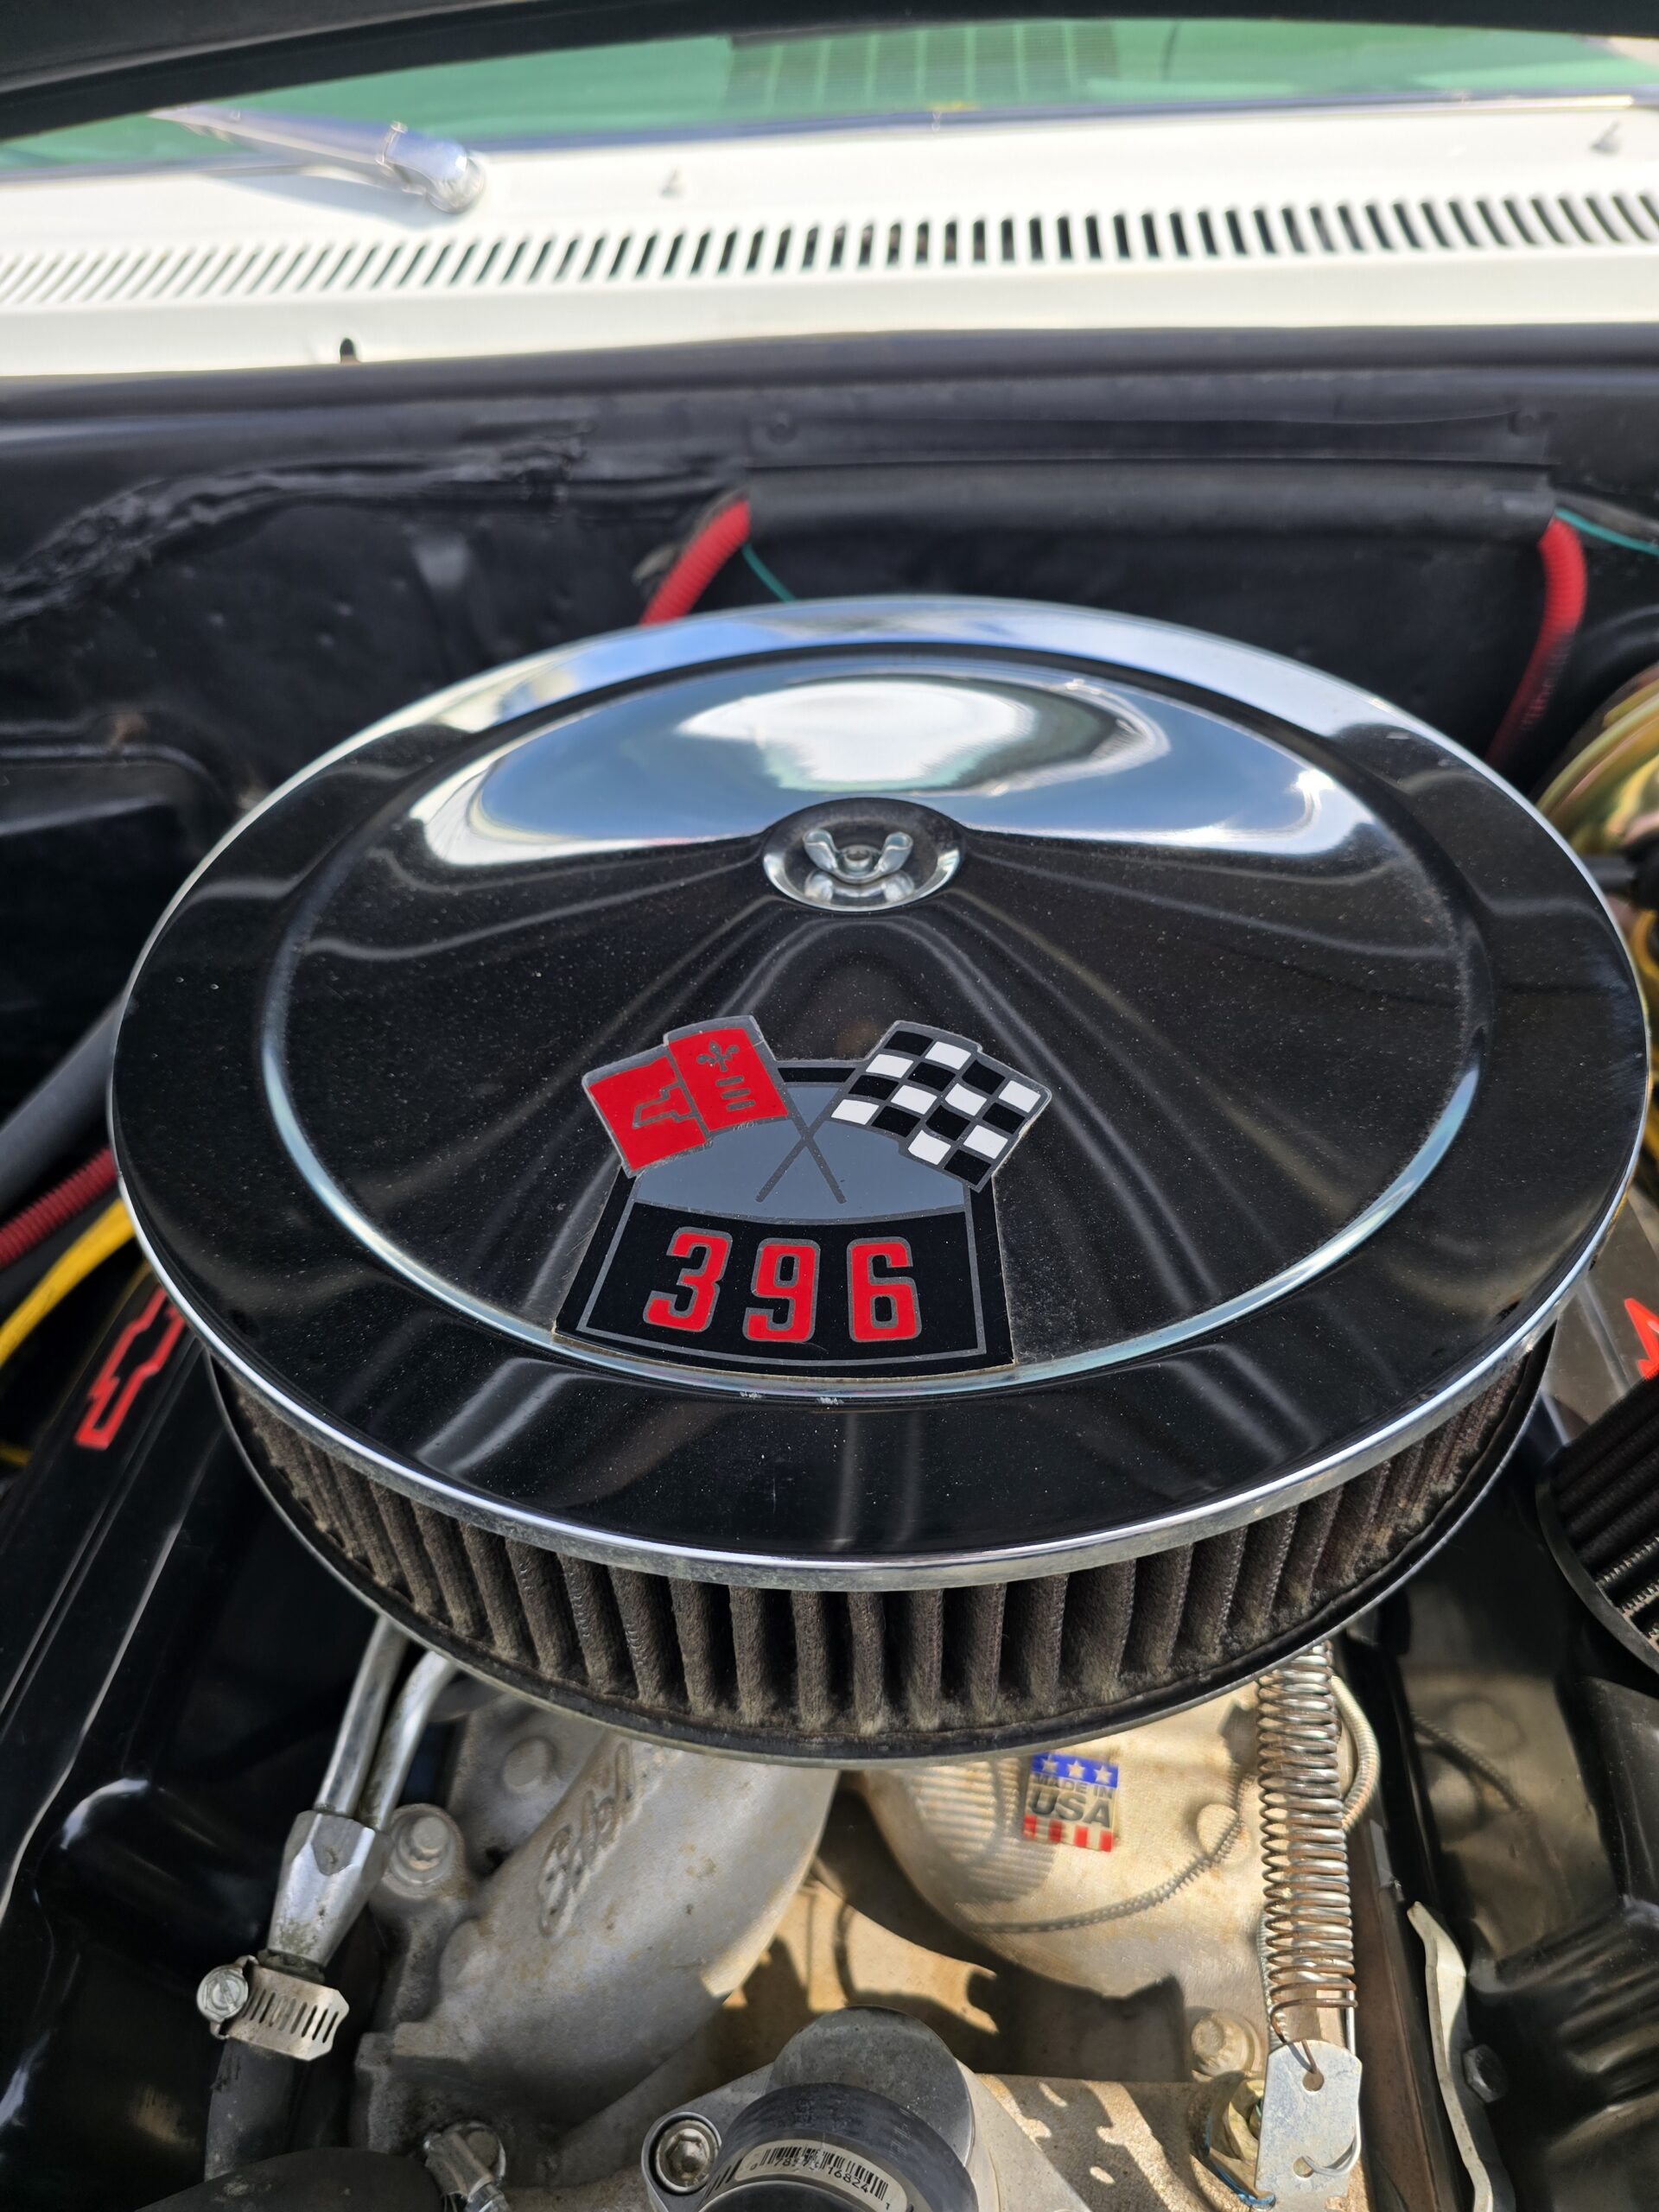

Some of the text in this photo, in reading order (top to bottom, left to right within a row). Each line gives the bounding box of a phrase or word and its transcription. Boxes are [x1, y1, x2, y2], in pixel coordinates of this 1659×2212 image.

[643, 1226, 922, 1343] 396
[1034, 1774, 1114, 1799] MADE IN
[1030, 1785, 1111, 1828] USA
[827, 2166, 869, 2194] 16824
